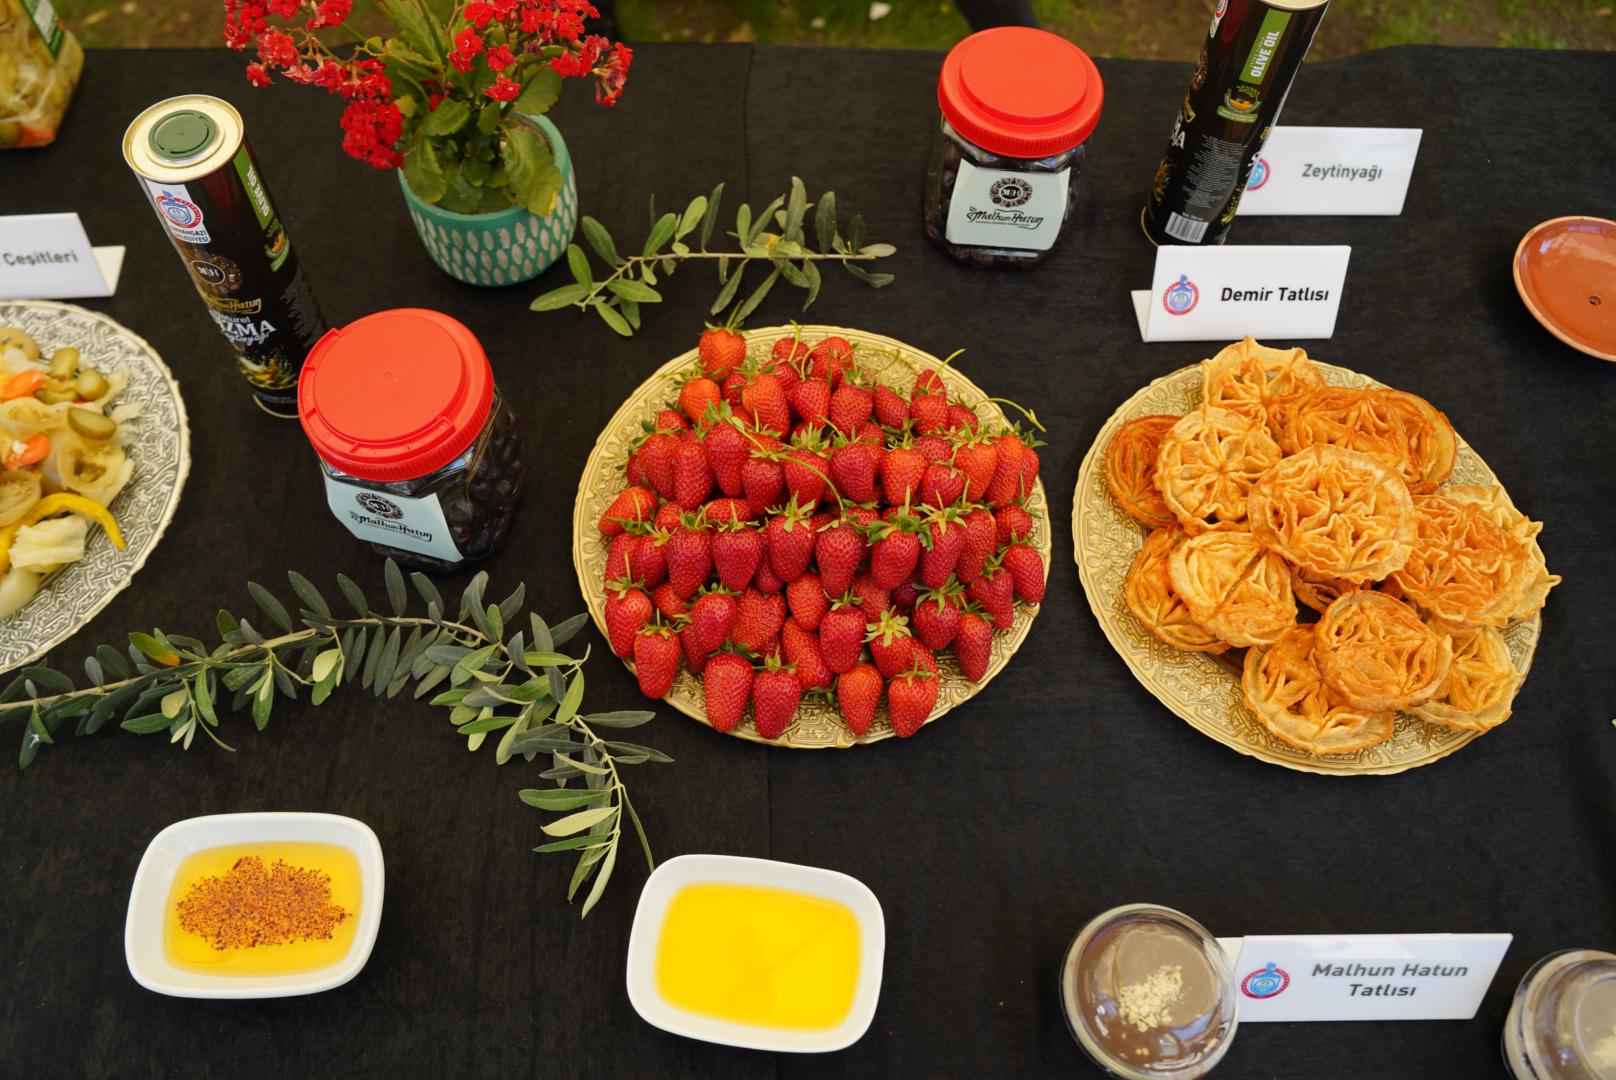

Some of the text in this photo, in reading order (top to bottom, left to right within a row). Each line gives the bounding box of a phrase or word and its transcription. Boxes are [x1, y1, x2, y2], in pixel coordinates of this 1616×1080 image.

[1250, 48, 1271, 78] OLIVE
[1263, 31, 1280, 48] OIL
[246, 164, 257, 187] OIL
[1301, 162, 1383, 182] Zeytinyağı
[254, 184, 270, 217] OLIVE
[4, 249, 79, 267] Çeşitleri
[1220, 286, 1273, 302] Demir
[1279, 286, 1330, 302] Tatlısı
[1311, 961, 1468, 978] Malhun Hatun
[1349, 983, 1416, 997] Tatlısı
